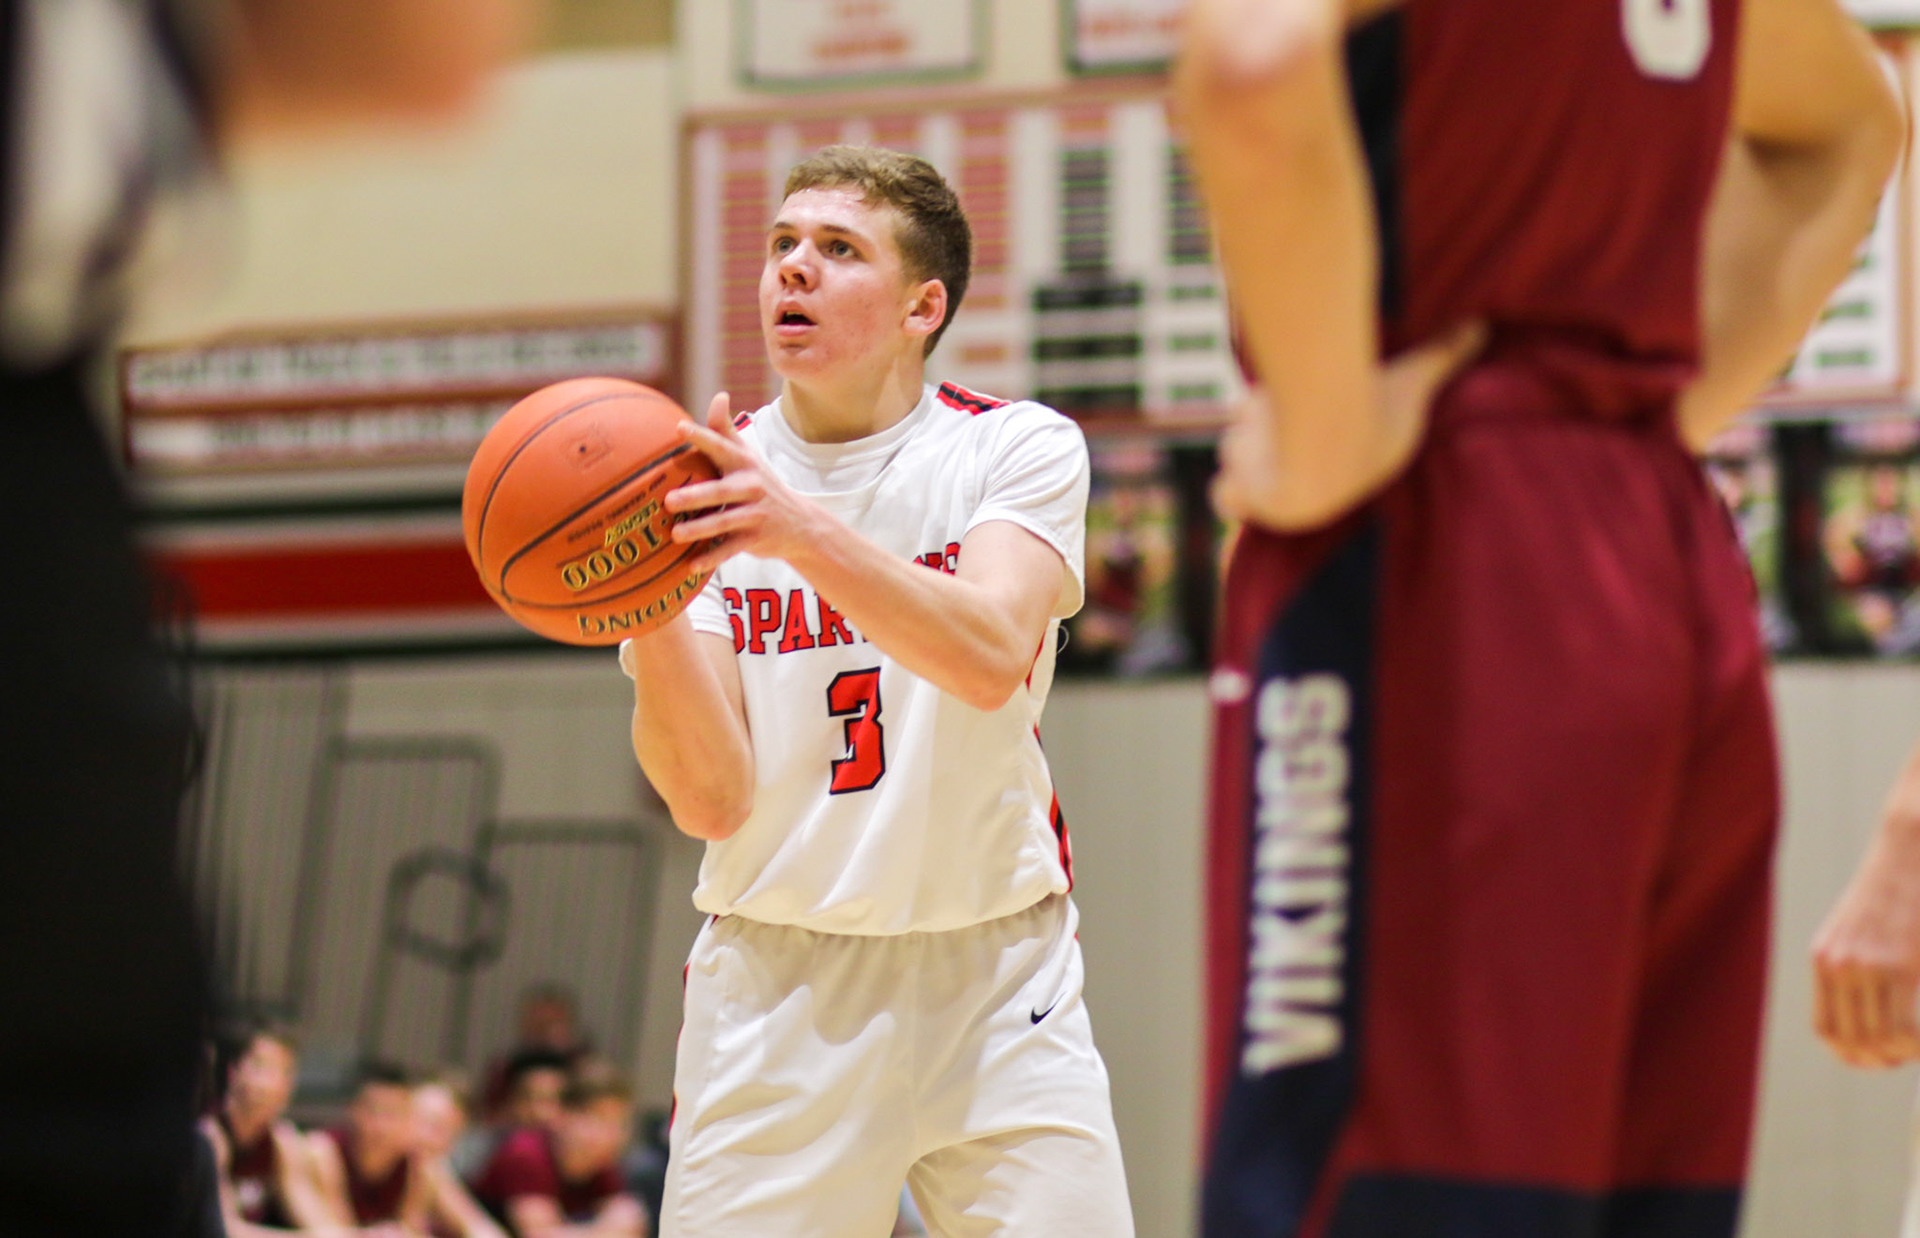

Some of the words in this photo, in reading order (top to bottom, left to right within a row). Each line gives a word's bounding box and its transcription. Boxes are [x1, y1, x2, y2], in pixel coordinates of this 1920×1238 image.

[577, 572, 708, 637] ALDING
[827, 666, 886, 795] 3
[1243, 672, 1352, 1078] VIKINGS
